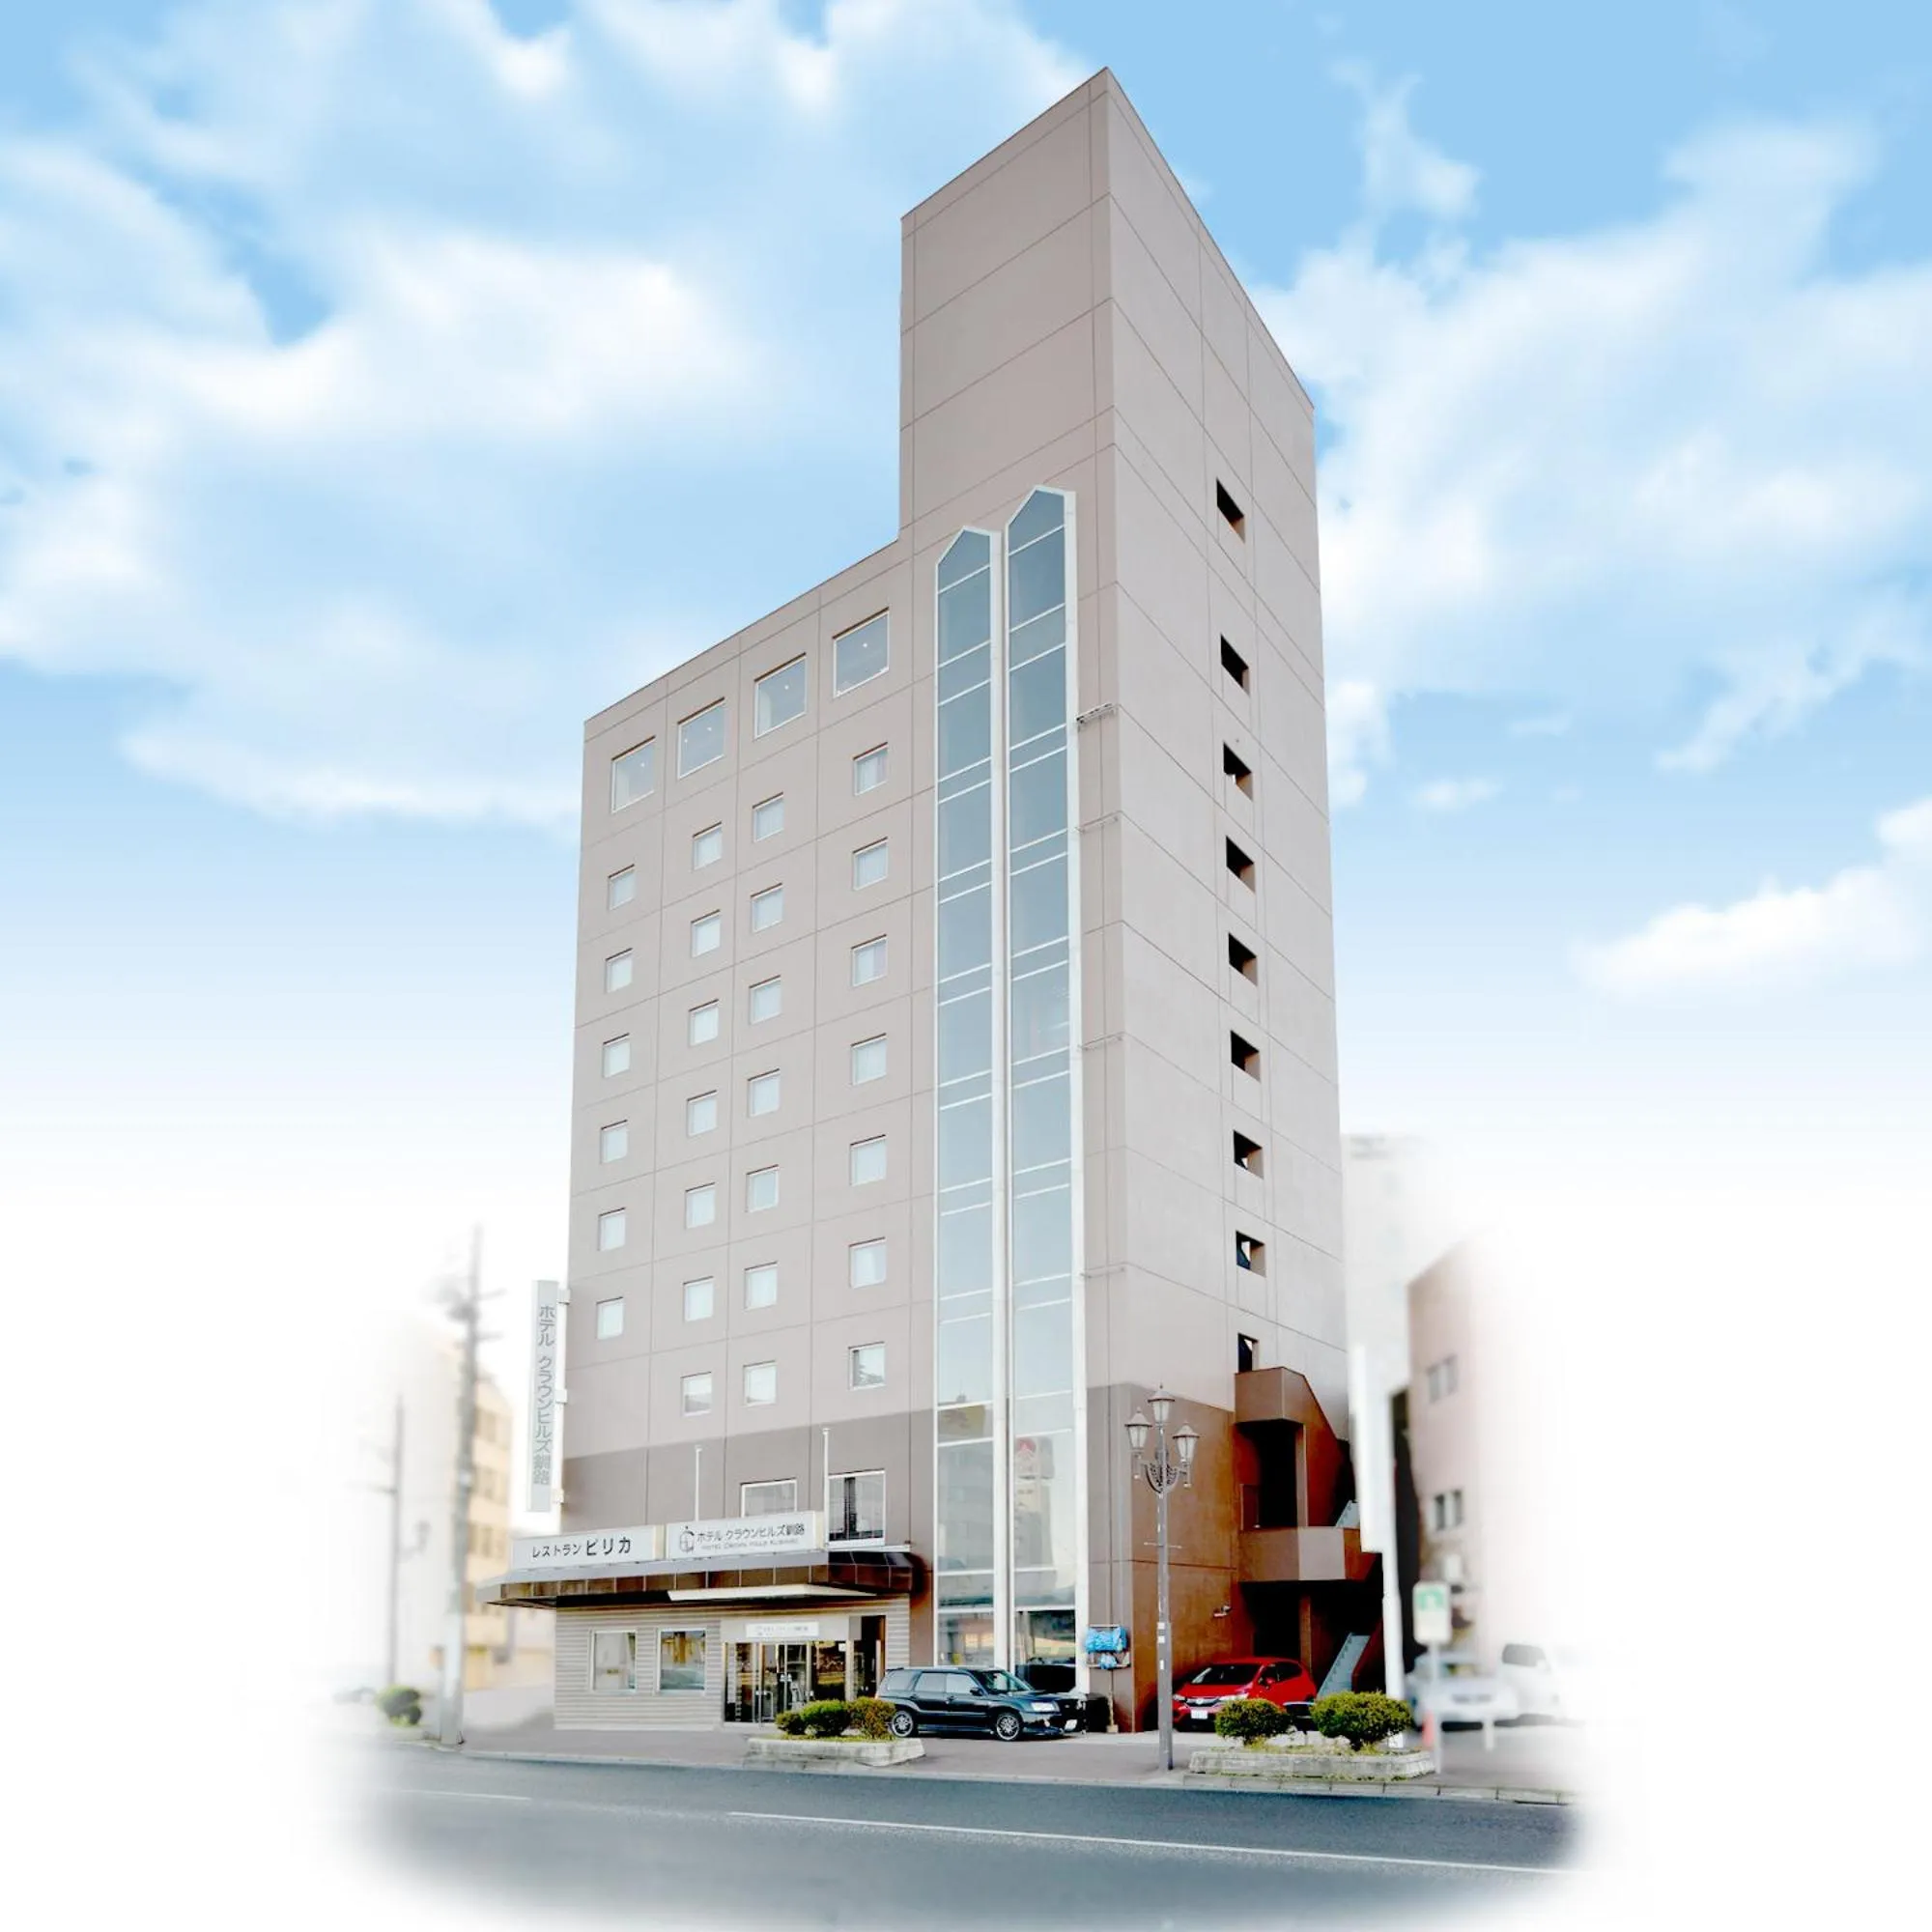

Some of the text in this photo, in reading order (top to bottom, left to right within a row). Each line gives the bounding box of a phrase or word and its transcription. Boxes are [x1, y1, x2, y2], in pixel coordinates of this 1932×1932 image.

[539, 1305, 555, 1347] ホテル
[696, 1531, 722, 1543] ホテル
[532, 1544, 582, 1558] レストラン
